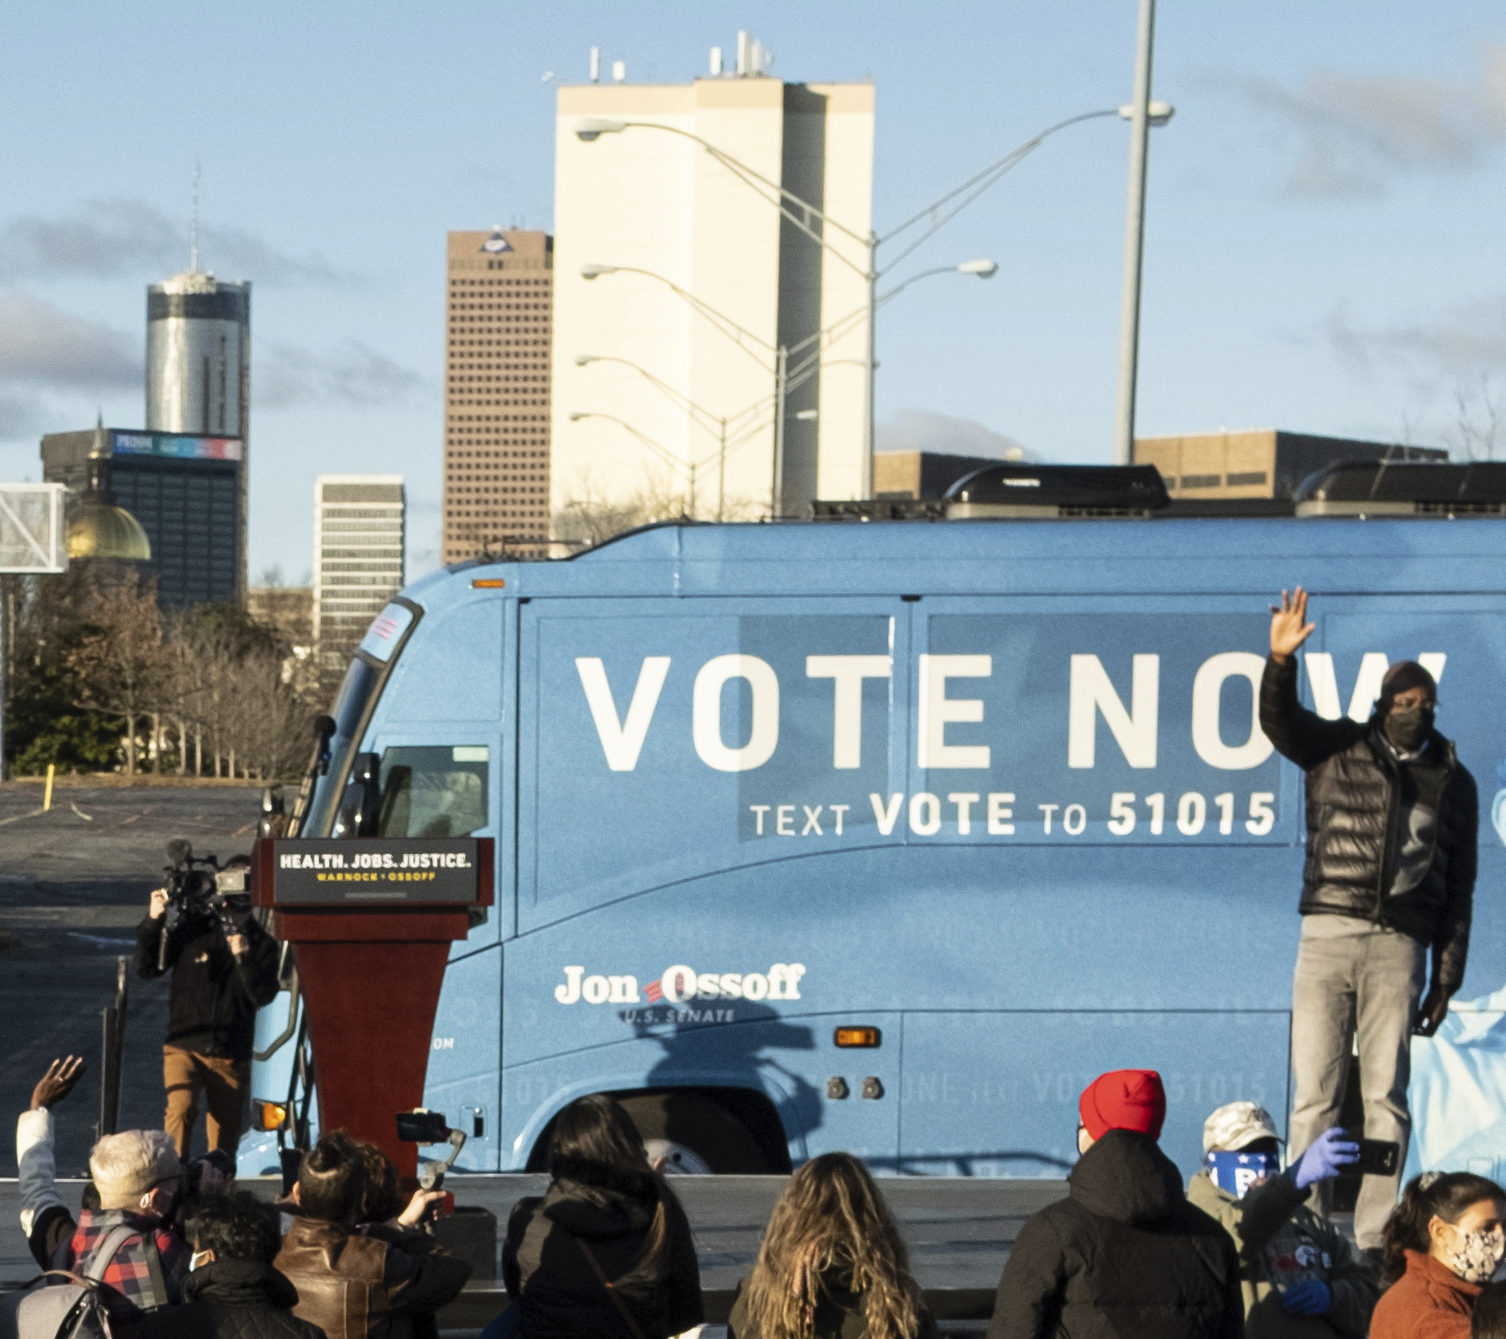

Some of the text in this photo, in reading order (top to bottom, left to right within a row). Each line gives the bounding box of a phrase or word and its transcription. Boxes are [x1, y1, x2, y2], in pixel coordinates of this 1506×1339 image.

[575, 651, 1446, 772] VOTE NOW
[750, 791, 1276, 836] TEXT VOTE TO 51015
[280, 852, 472, 869] HEALTH. JOBS. JUSTICE.
[316, 871, 436, 883] WARNOCK OSSOFF
[555, 963, 806, 1005] Jon Ossoff
[624, 1009, 735, 1024] U.S. SENATE
